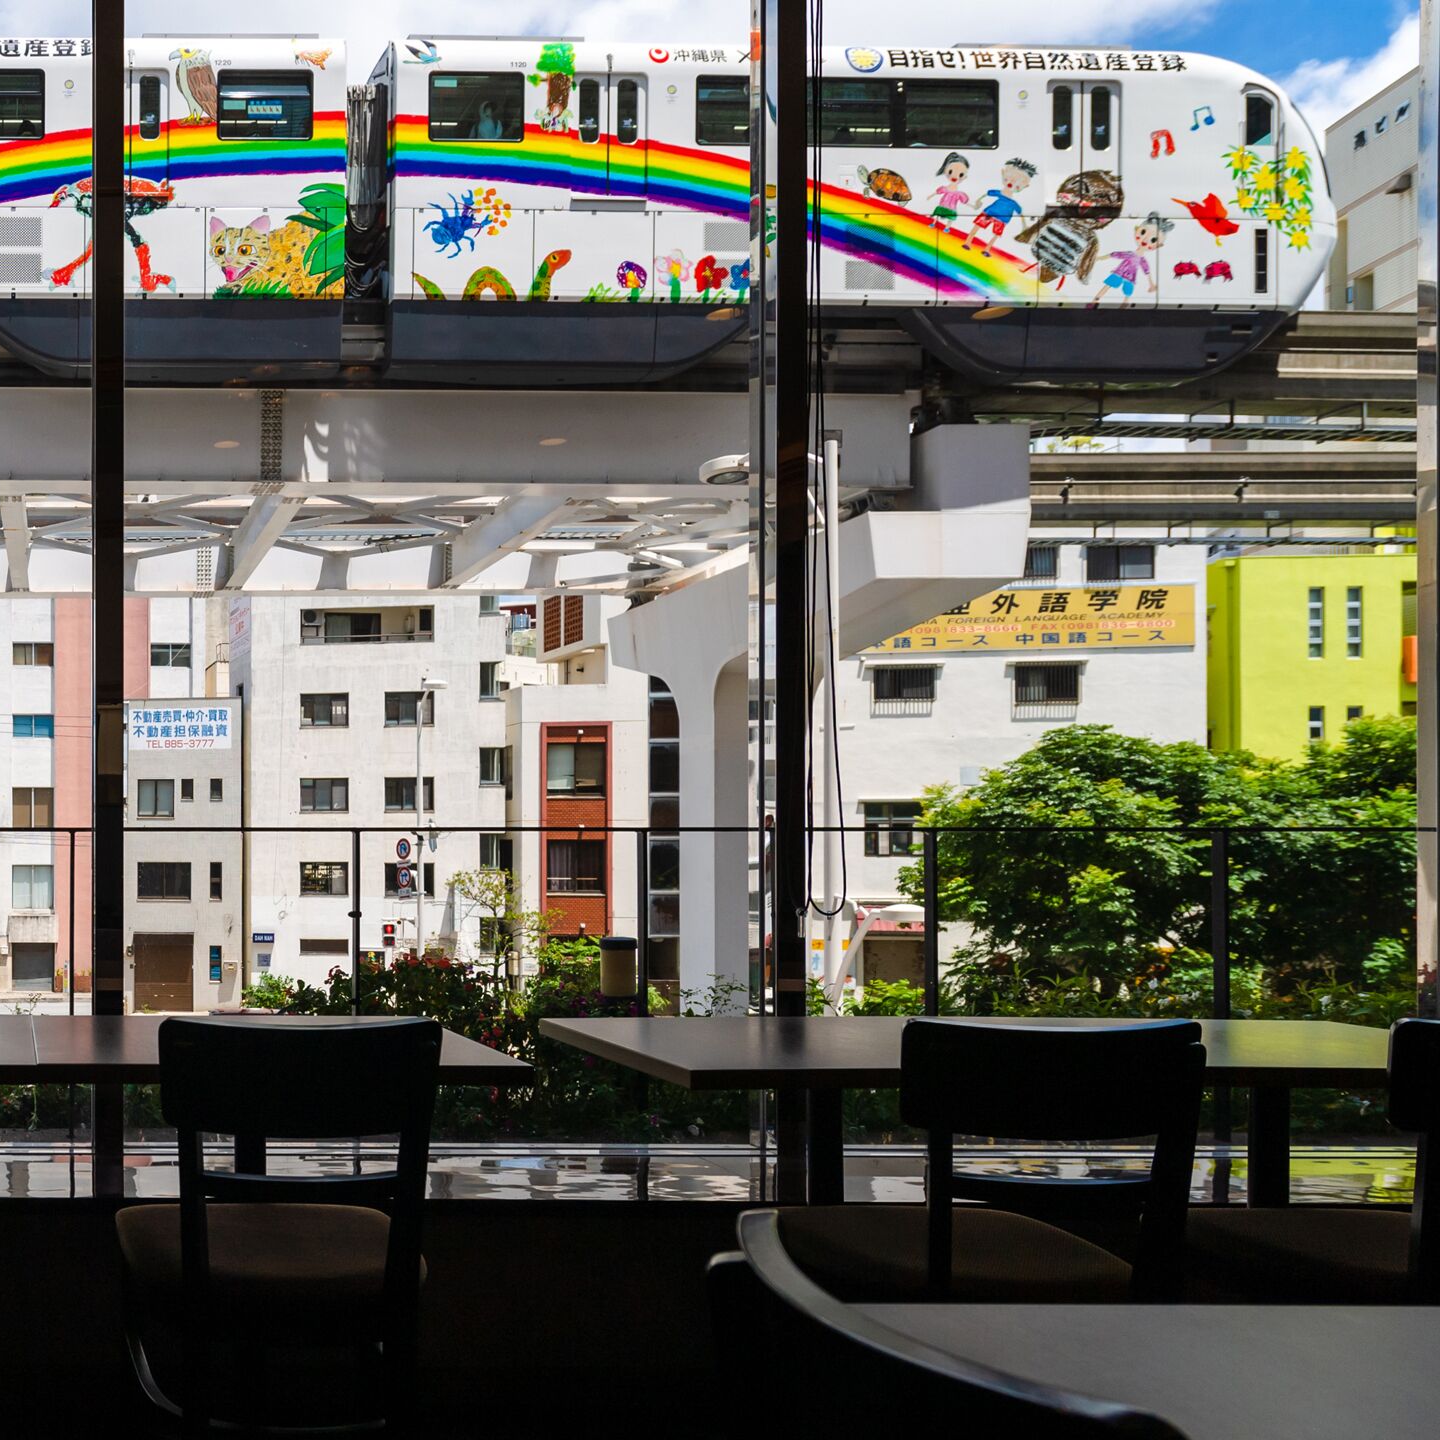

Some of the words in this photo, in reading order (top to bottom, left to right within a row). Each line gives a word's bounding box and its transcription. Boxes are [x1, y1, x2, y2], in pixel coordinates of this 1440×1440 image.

[673, 48, 728, 63] 沖縄県
[947, 616, 1006, 624] FOREIGN
[1015, 613, 1088, 622] LANGUAGE
[1098, 611, 1166, 620] ACADEMY
[1031, 623, 1058, 631] FAX
[133, 724, 228, 738] 不動産担保融資
[146, 740, 163, 749] TEL
[164, 739, 215, 748] 885-3777
